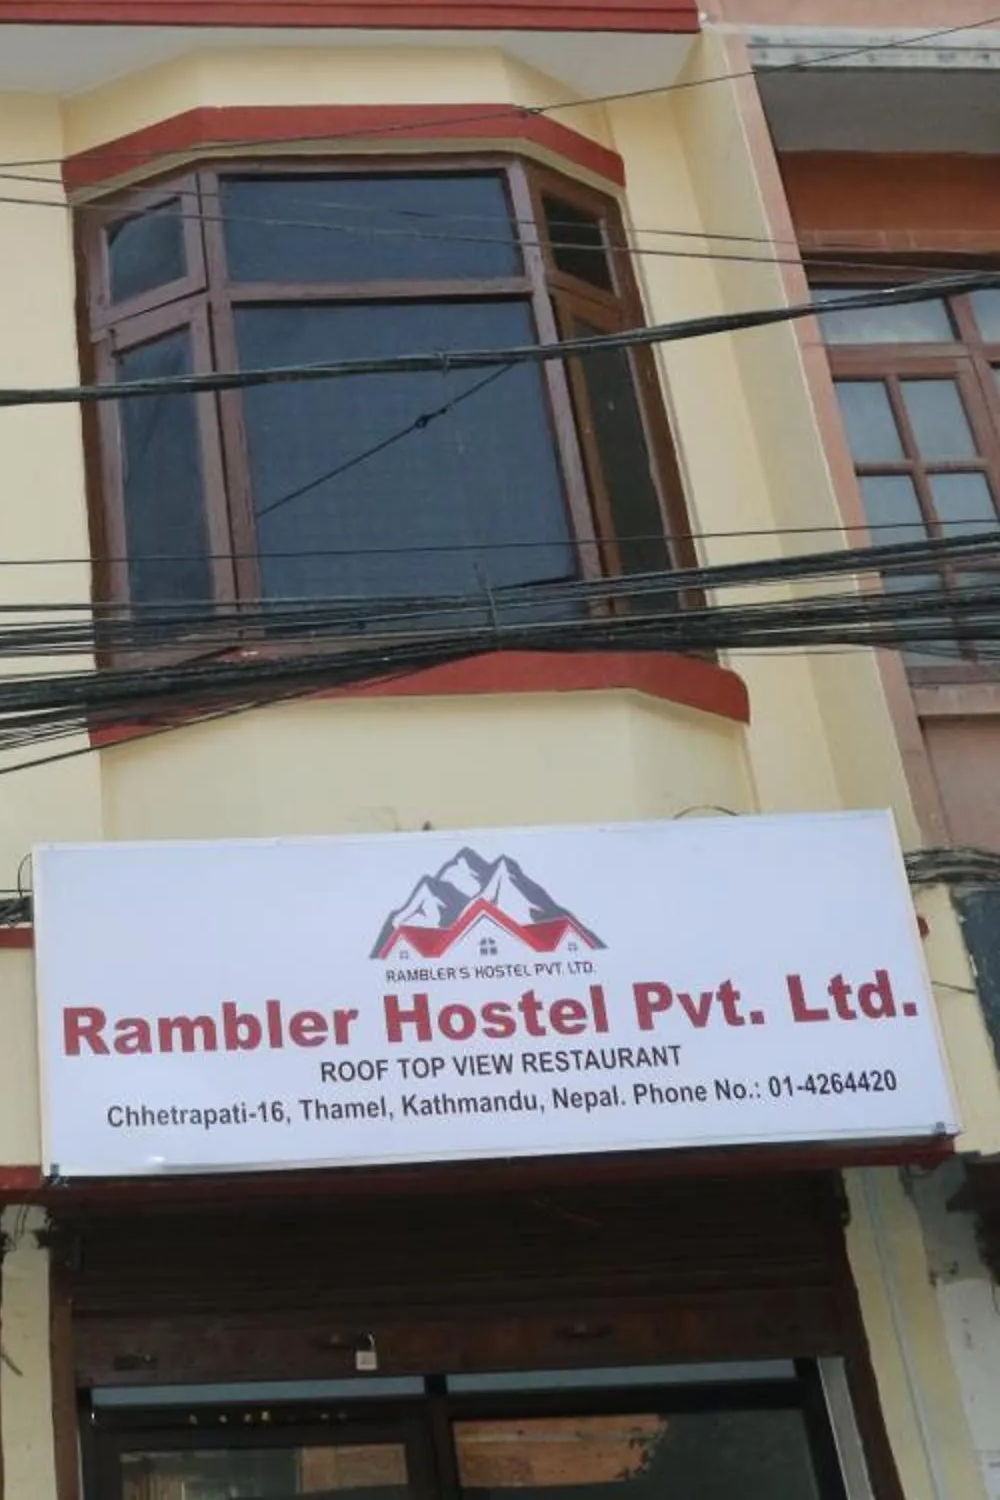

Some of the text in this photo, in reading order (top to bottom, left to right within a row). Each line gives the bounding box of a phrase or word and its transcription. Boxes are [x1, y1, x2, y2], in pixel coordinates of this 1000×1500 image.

[475, 963, 531, 979] HOSTEL
[63, 969, 917, 1057] Rambler Hostel Pvt. Ltd.
[320, 1045, 682, 1084] ROOF TOP VIEW RESTAURANT
[107, 1068, 897, 1131] Chhetrapati-16, Thamel, Kathmandu, Nepal. Phone No.: 01-4264420
